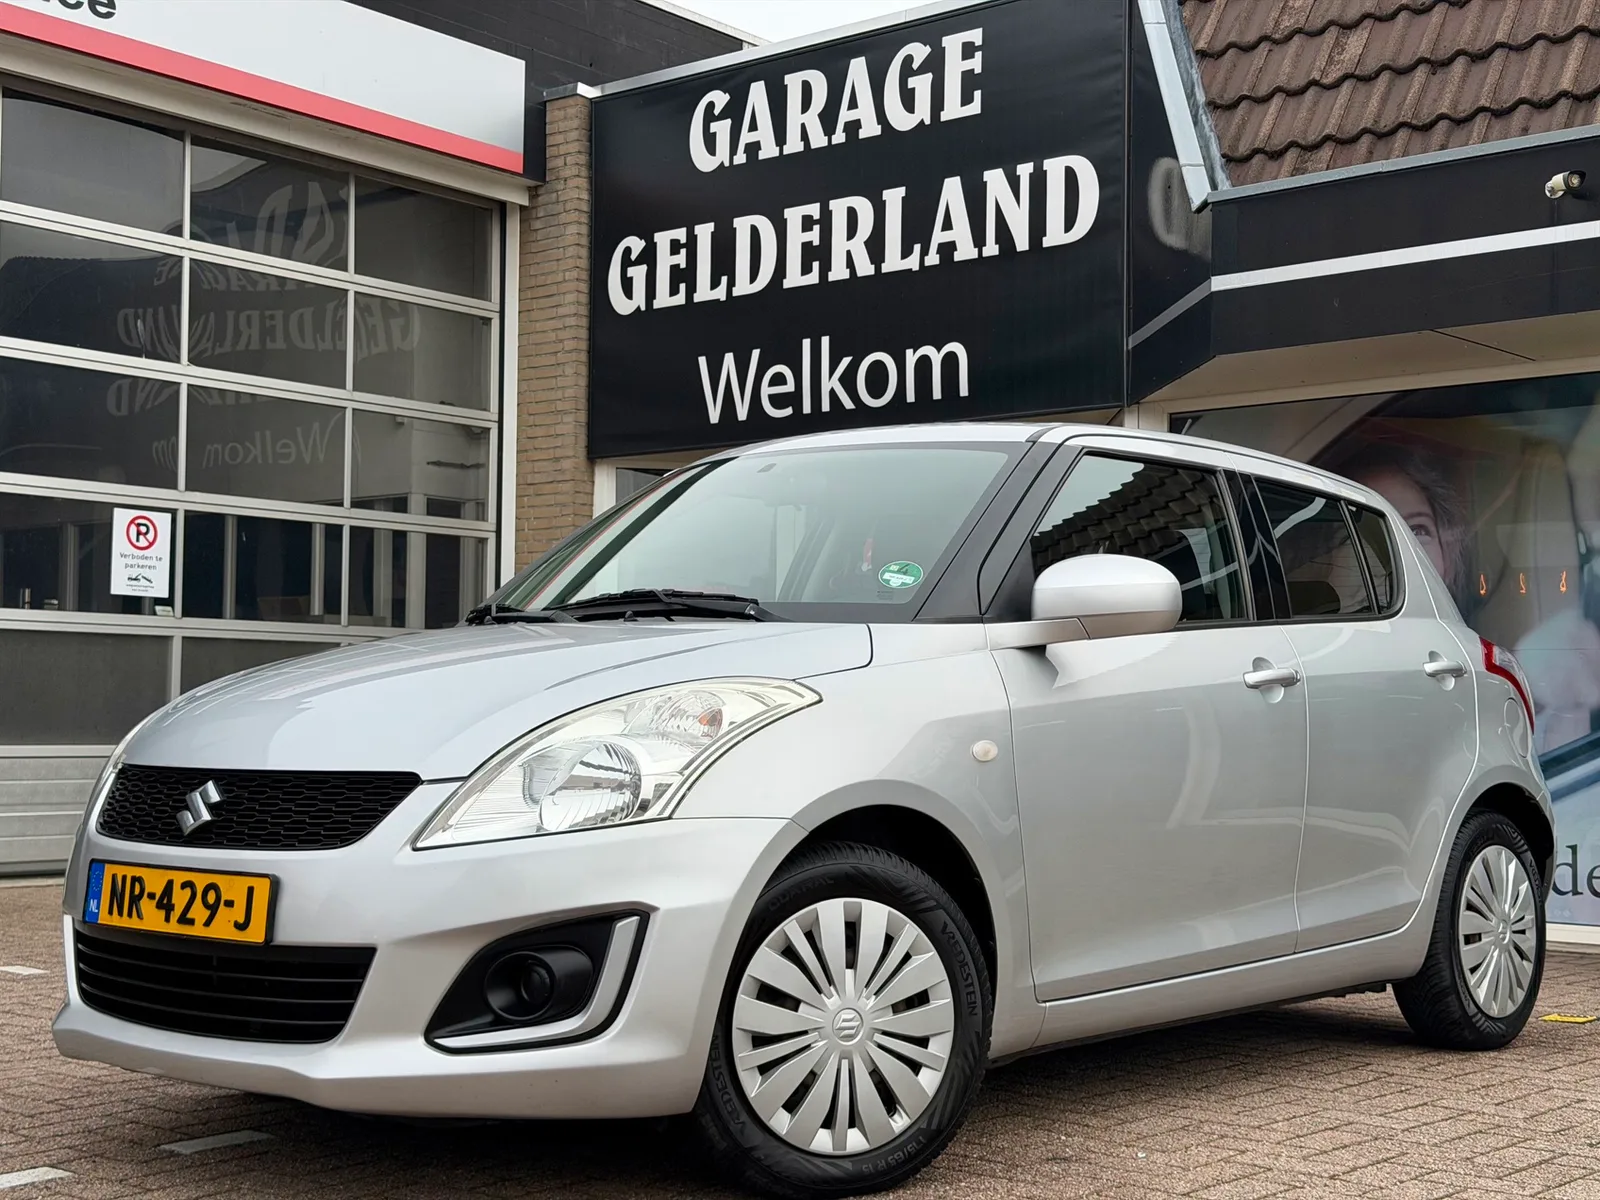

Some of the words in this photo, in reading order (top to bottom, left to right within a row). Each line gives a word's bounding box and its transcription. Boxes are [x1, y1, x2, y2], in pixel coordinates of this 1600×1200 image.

[689, 27, 983, 172] GARAGE
[607, 155, 1100, 315] GELDERLAND
[698, 335, 970, 424] Welkom
[119, 552, 153, 561] Verboden
[124, 562, 157, 570] parkeren
[89, 898, 99, 913] NL
[108, 873, 255, 932] NR-429-J
[940, 920, 978, 1016] VREDESTEIN
[876, 1159, 887, 1169] R
[887, 1135, 927, 1166] 175/65
